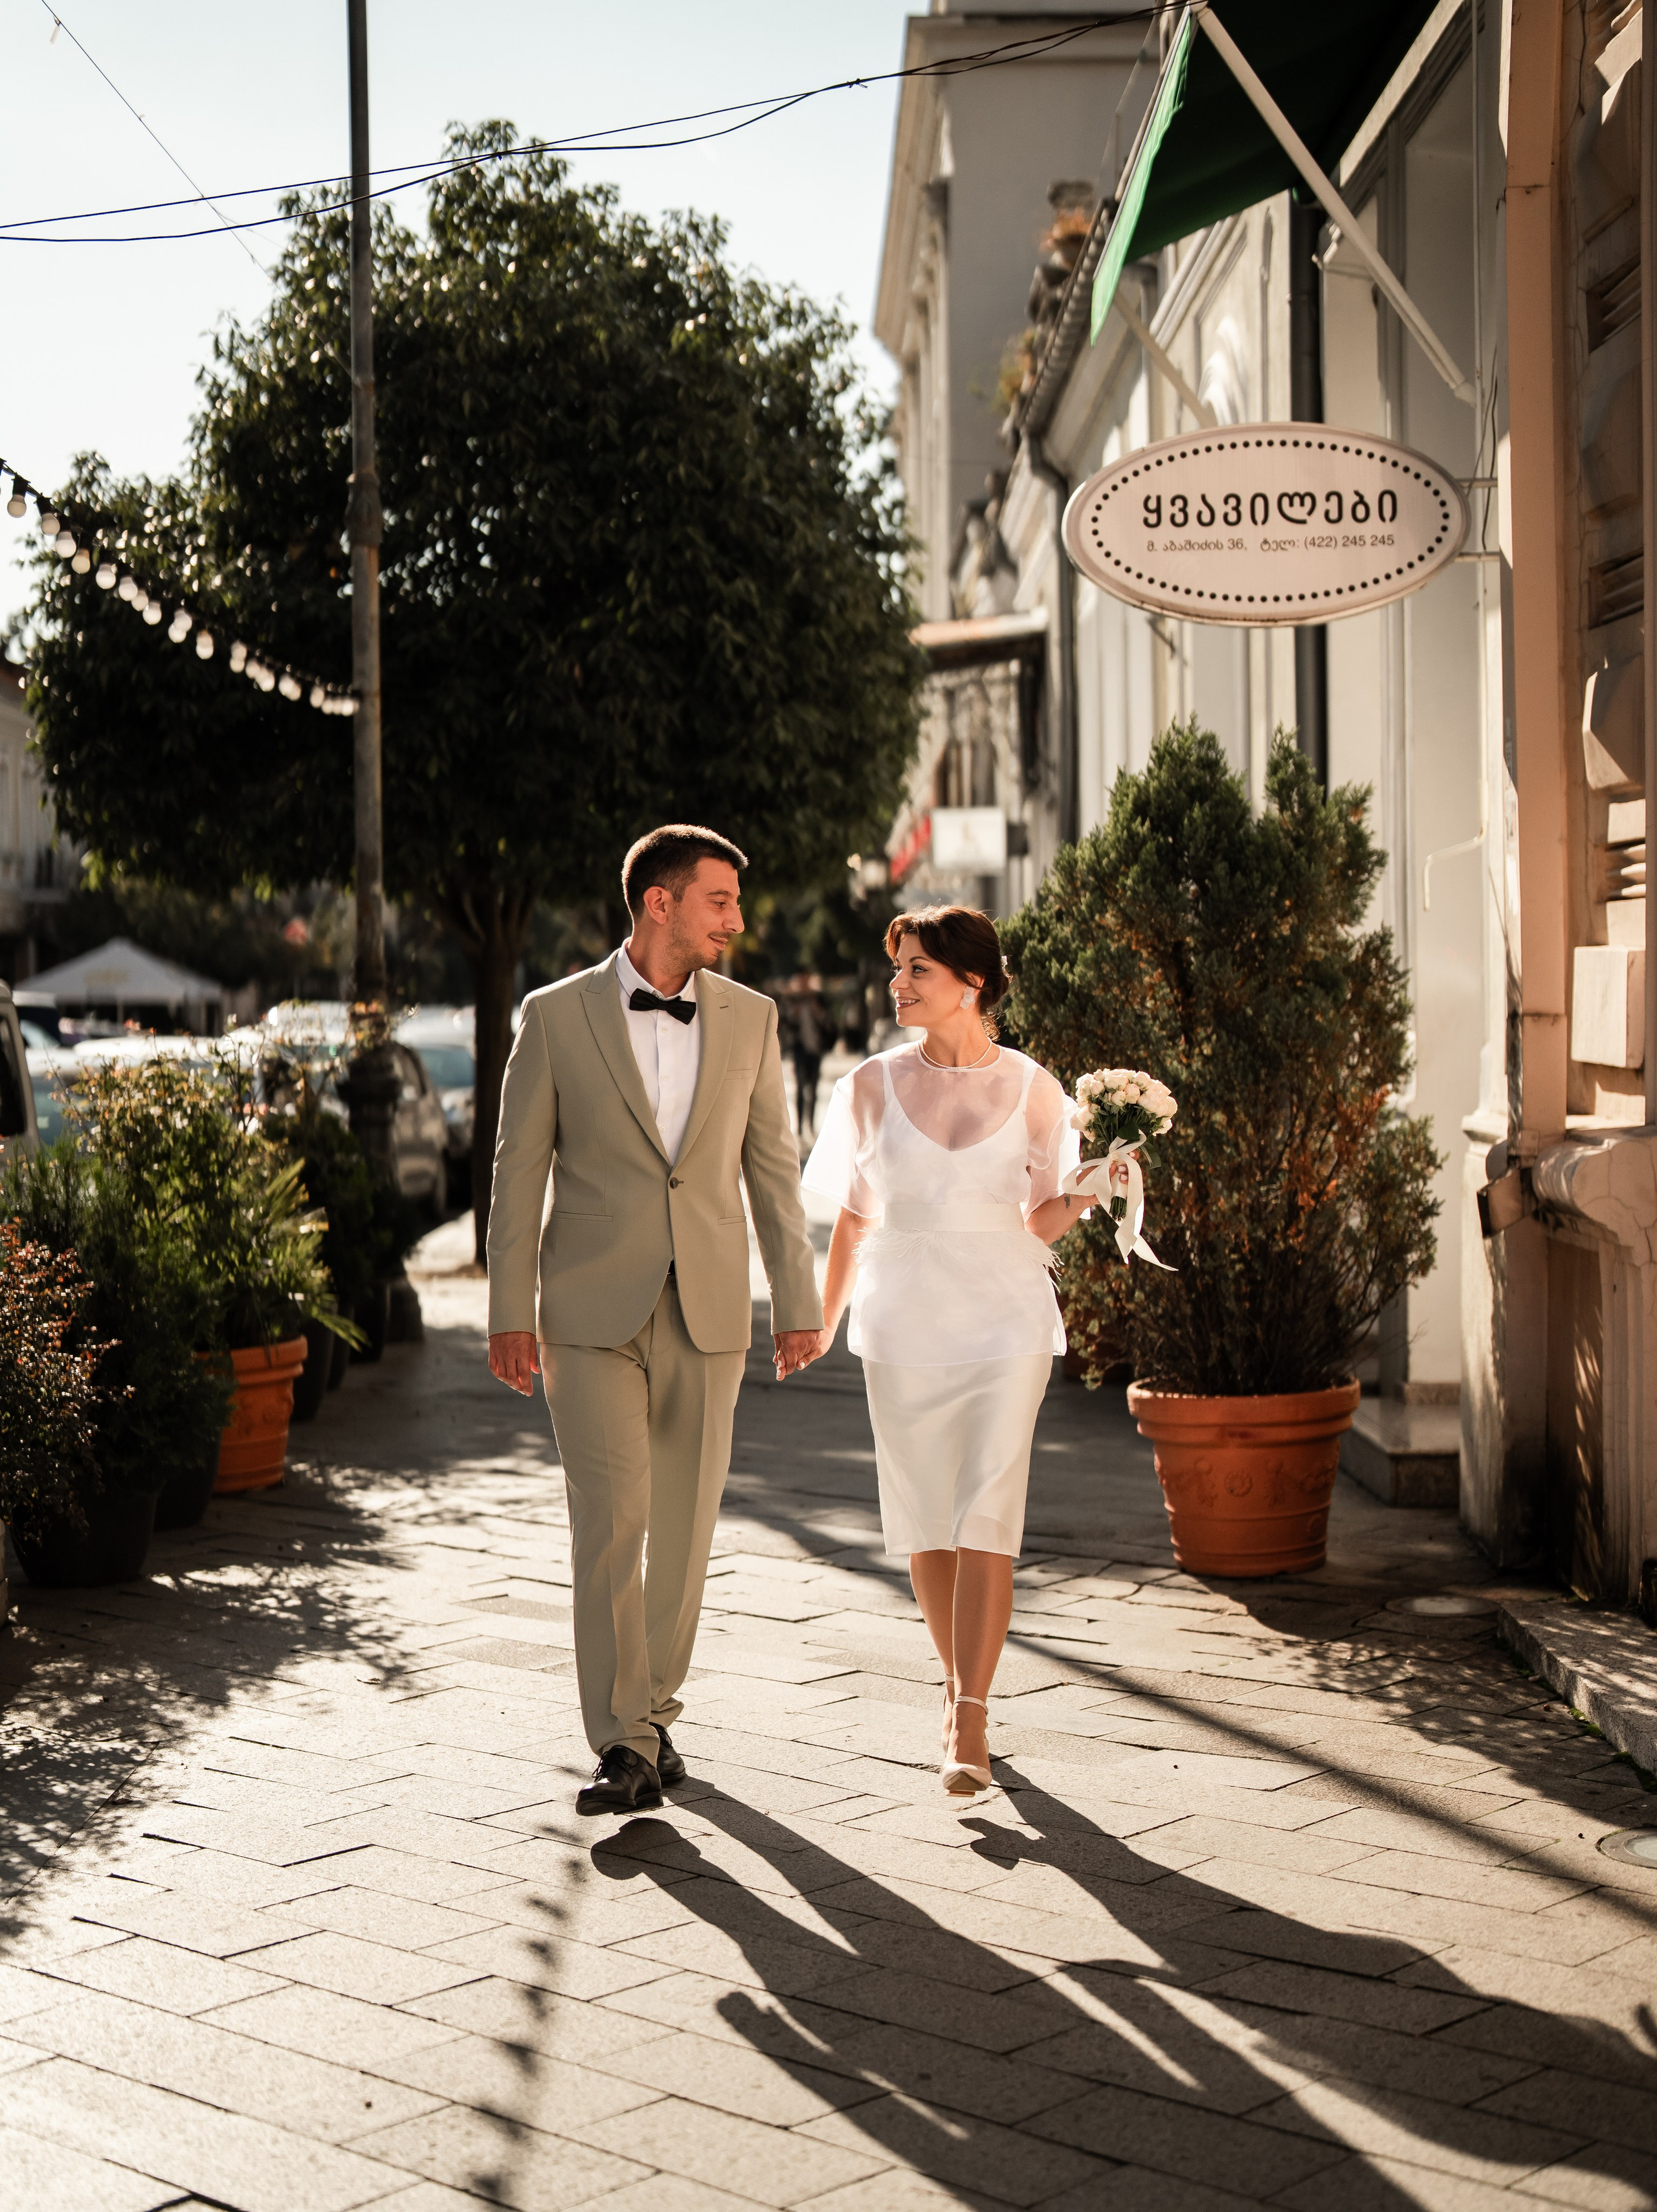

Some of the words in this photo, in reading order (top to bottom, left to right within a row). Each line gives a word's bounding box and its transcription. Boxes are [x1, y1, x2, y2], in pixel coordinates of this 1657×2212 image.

[1142, 489, 1398, 528] ყვავილები
[1147, 540, 1157, 552] მ.
[1163, 539, 1223, 551] აბაშიძის
[1227, 538, 1247, 552] 36,
[1260, 538, 1299, 551] ტელ:
[1304, 535, 1337, 550] (422)
[1342, 535, 1366, 546] 245
[1370, 533, 1395, 546] 245
